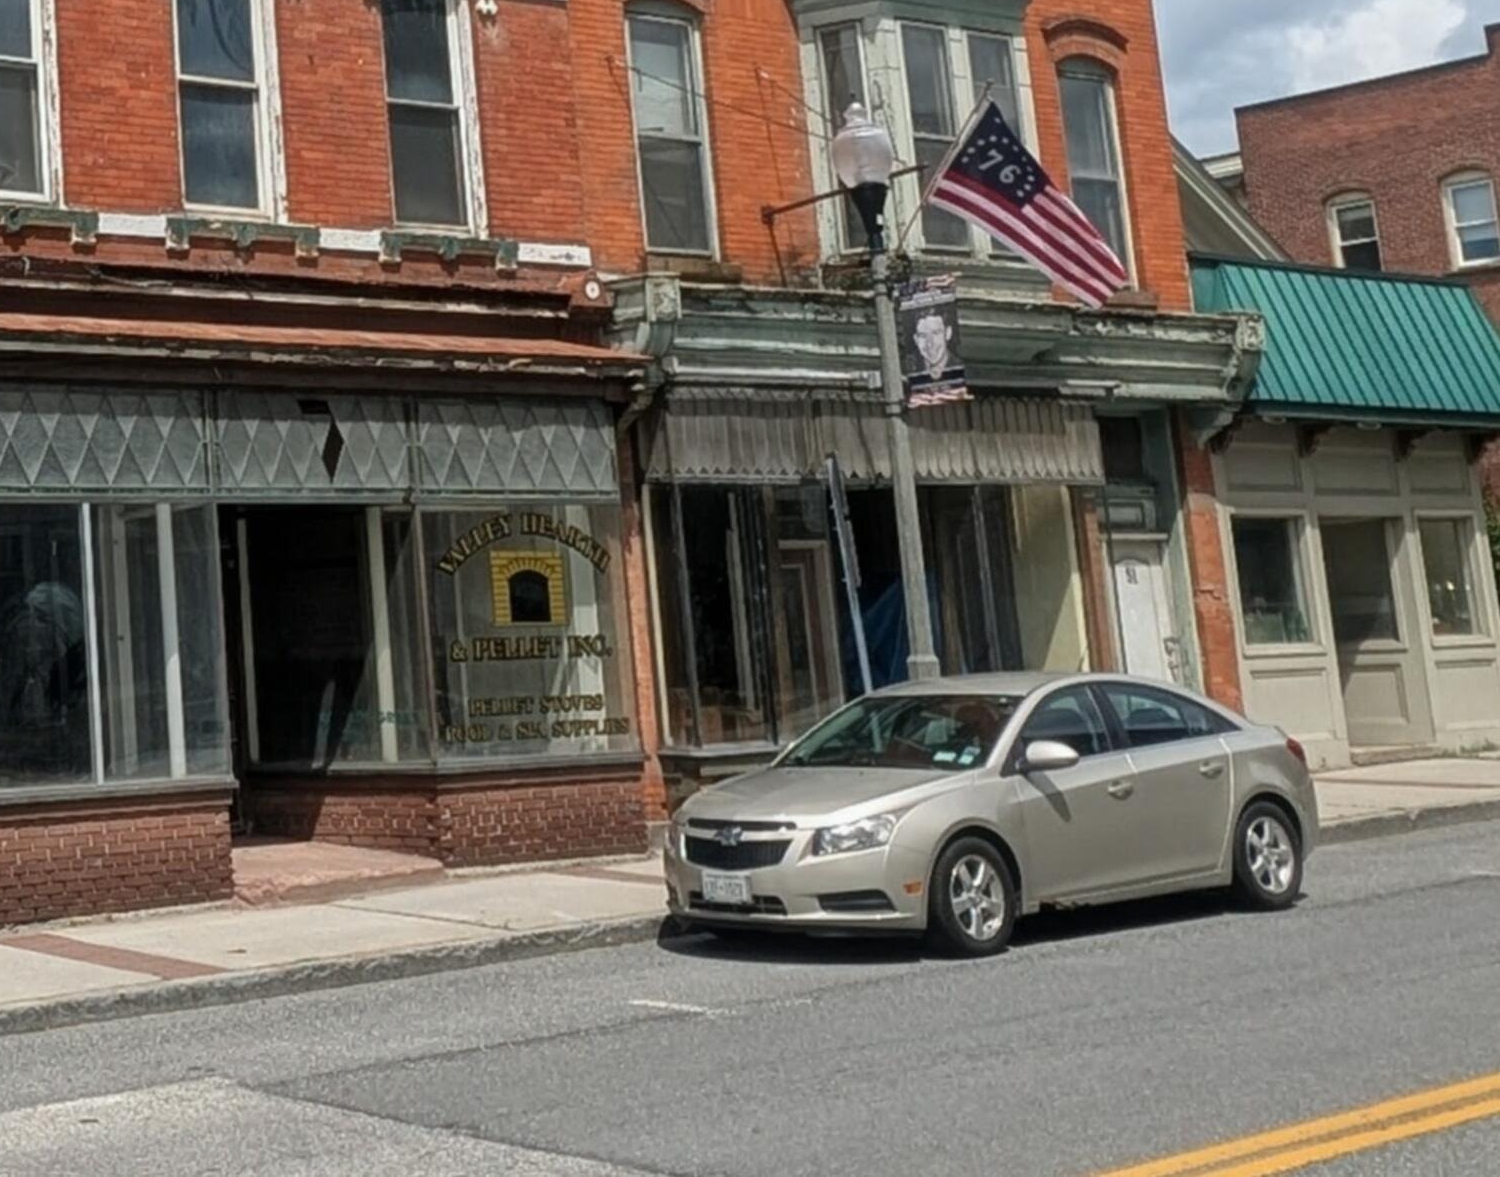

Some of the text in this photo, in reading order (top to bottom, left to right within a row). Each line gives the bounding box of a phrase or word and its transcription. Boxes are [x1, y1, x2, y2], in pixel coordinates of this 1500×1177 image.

[978, 149, 1021, 184] 76
[437, 513, 611, 576] VALLEY HEARTH
[451, 635, 612, 662] & PELLET INC.
[469, 694, 604, 717] PELLET STOVES
[551, 718, 630, 739] SUPPLIES
